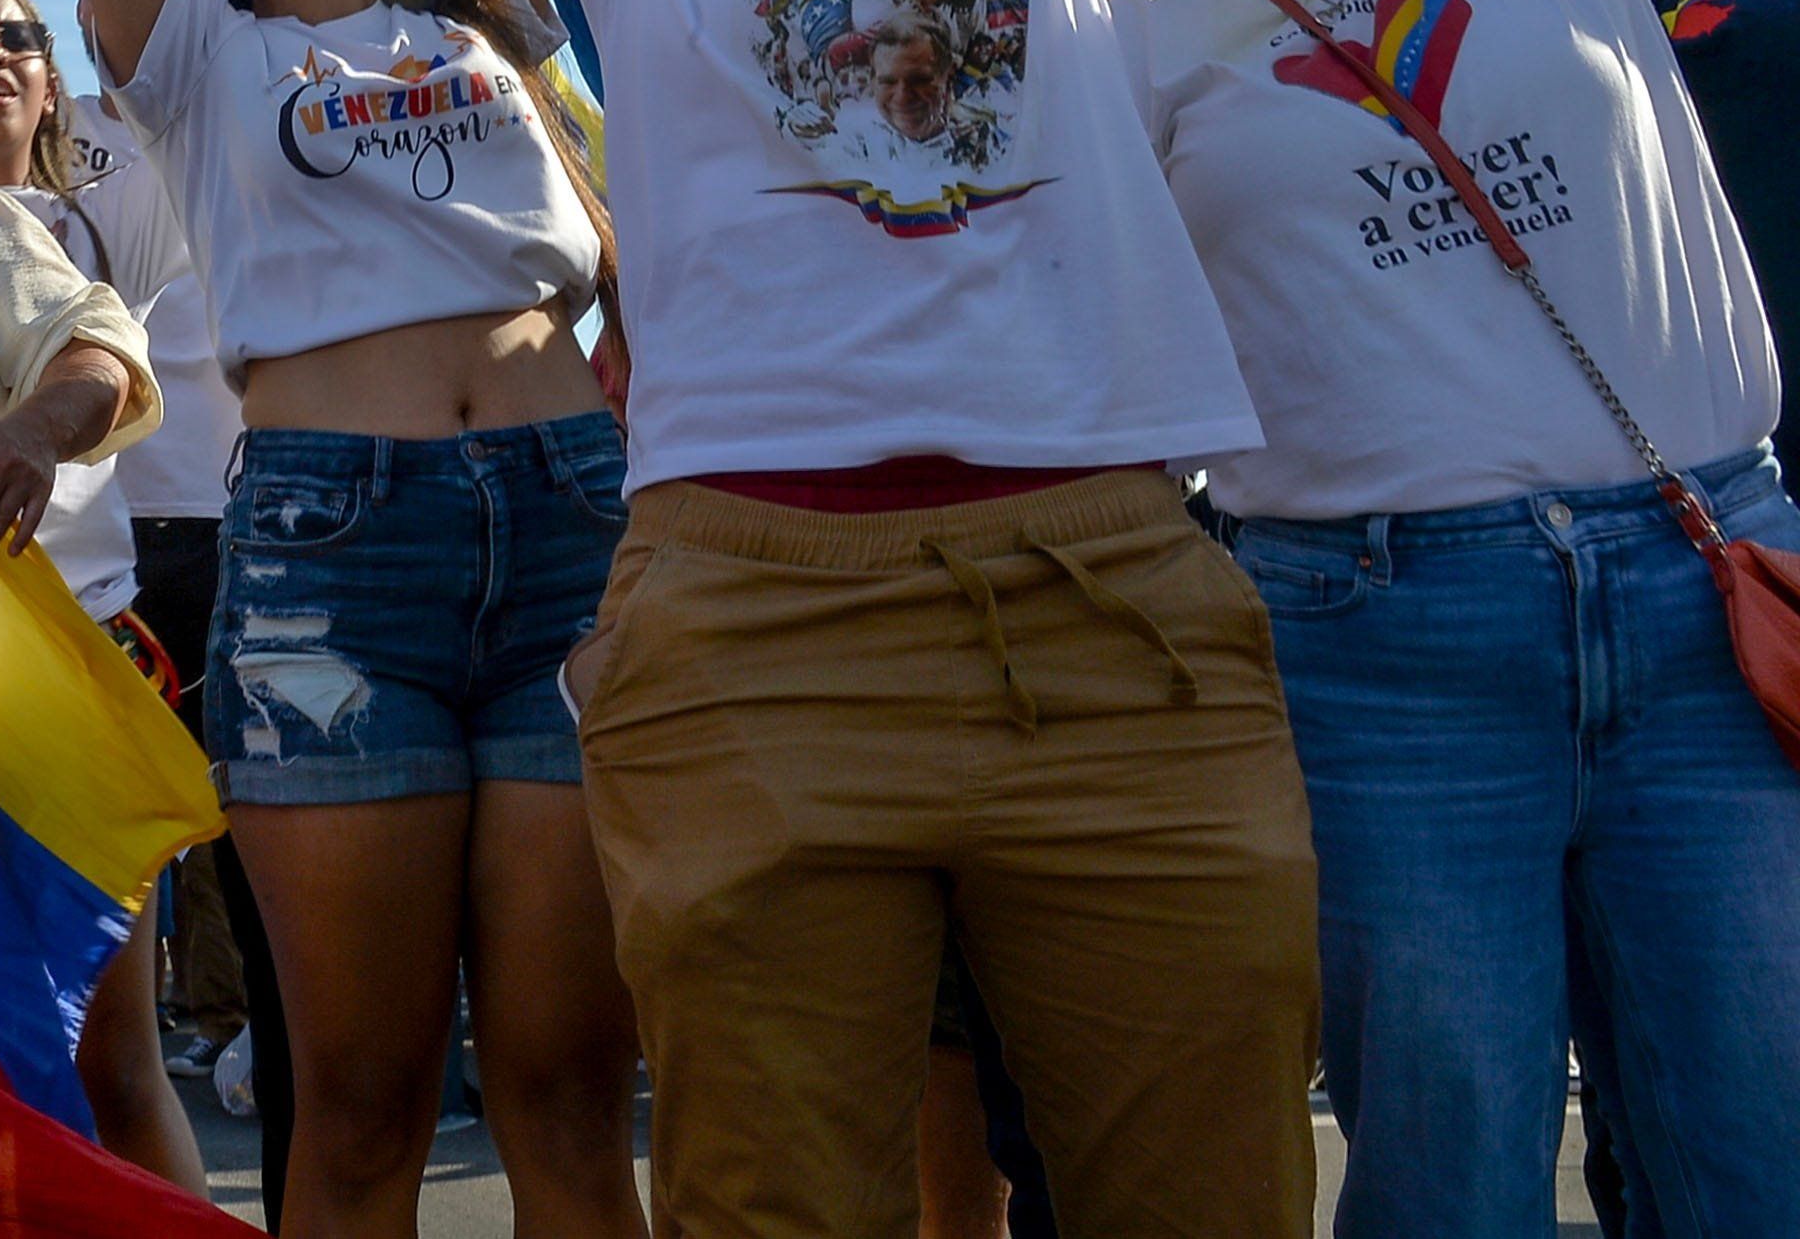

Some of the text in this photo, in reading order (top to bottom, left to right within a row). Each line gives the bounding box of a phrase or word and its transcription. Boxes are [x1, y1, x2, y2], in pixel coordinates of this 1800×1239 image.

[278, 80, 492, 202] Corazon
[298, 72, 494, 137] VENEZUELA
[1358, 153, 1569, 248] a crer!
[1371, 202, 1574, 271] en veneuela
